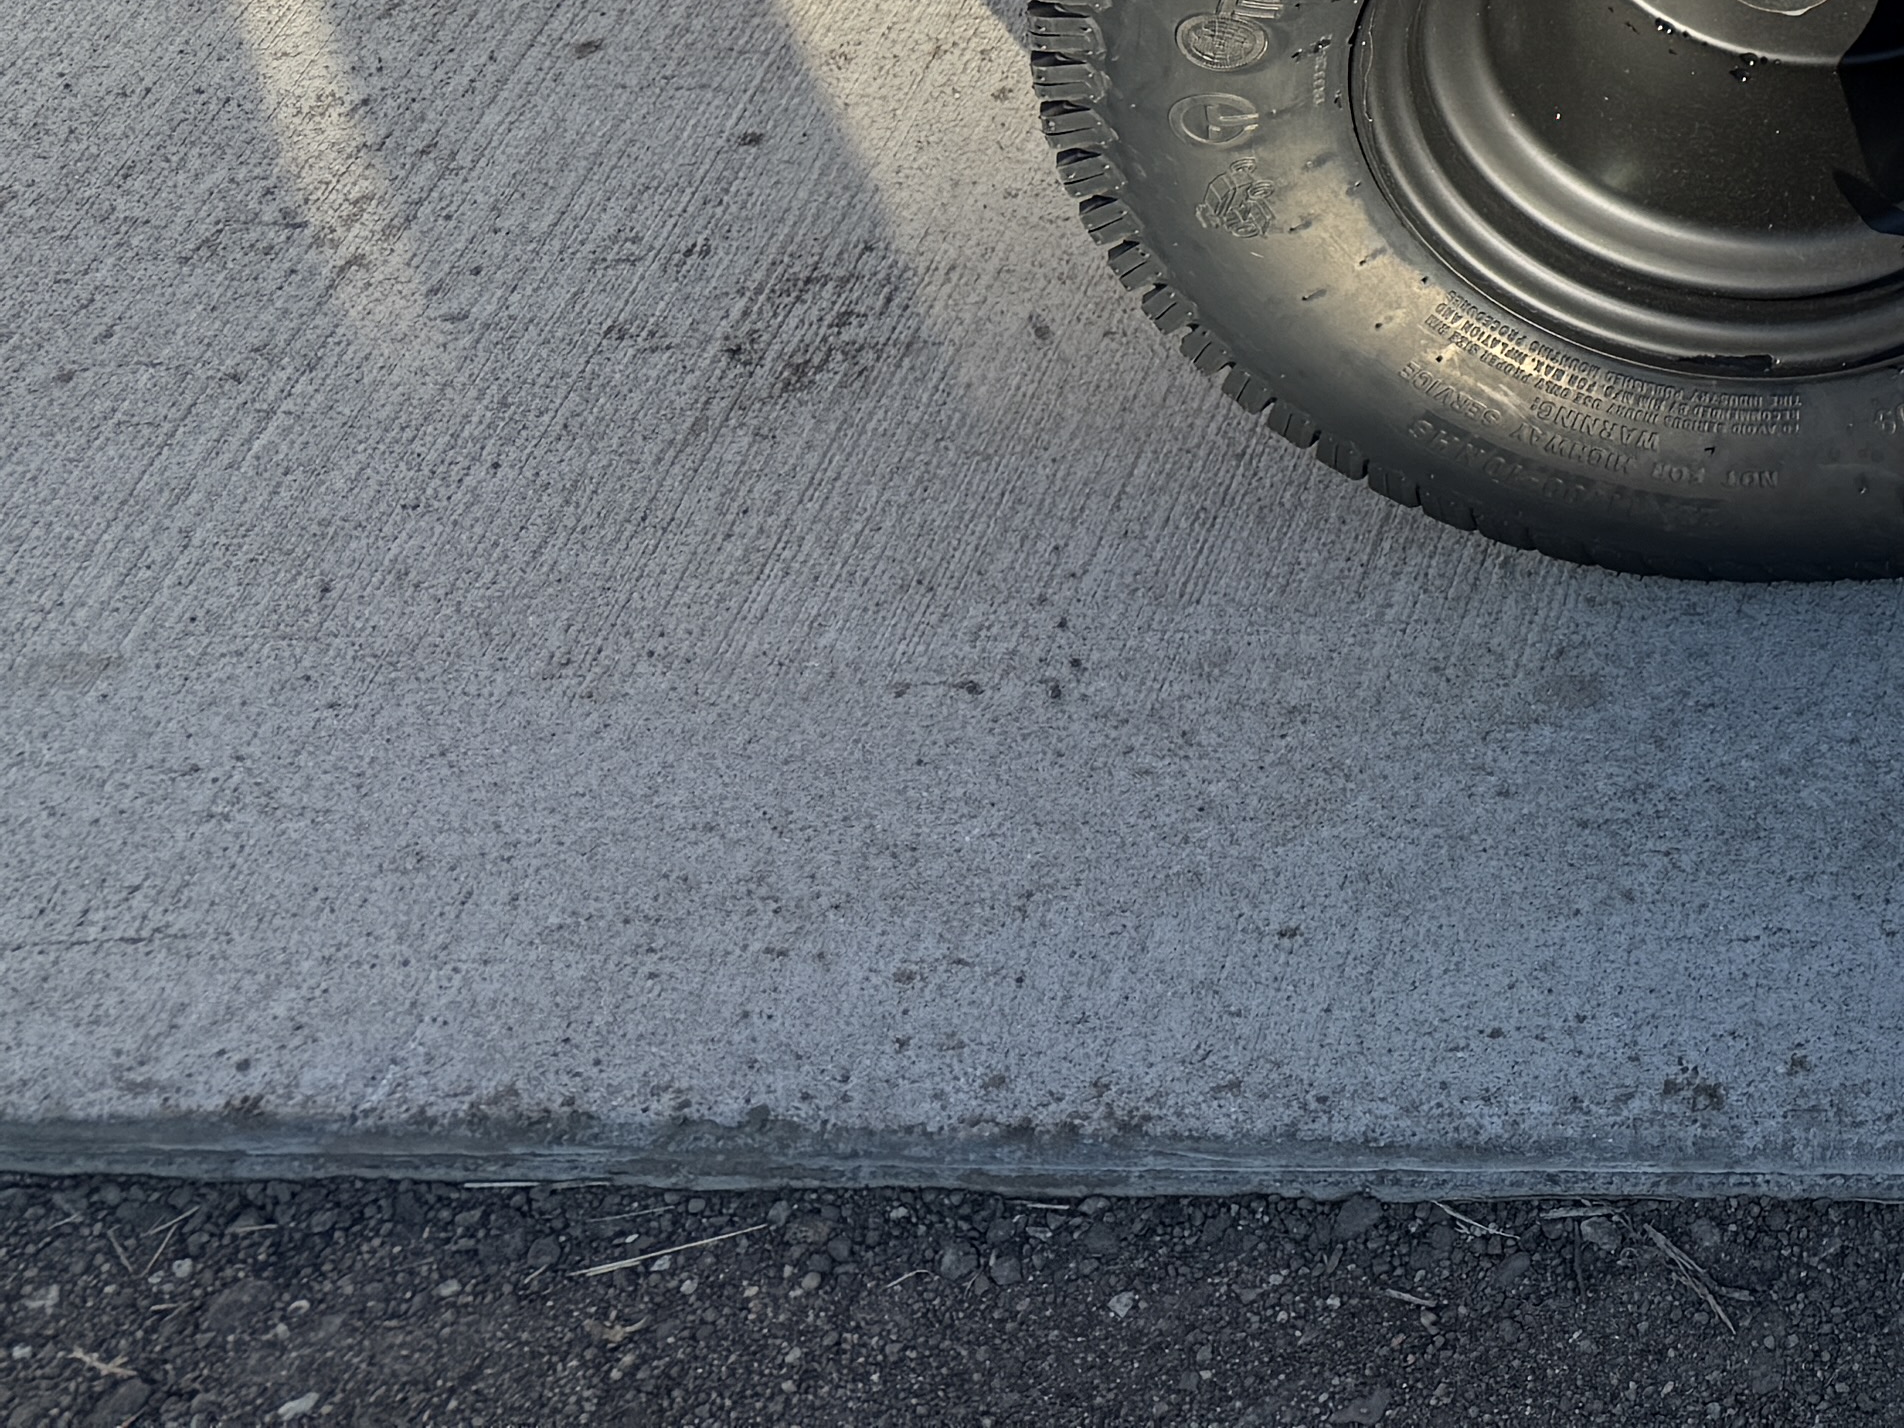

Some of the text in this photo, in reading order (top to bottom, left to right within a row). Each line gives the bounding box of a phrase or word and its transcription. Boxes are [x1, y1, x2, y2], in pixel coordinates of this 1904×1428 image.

[1424, 312, 1450, 337] RIM
[1434, 300, 1464, 327] AND
[1444, 289, 1527, 347] PROCEDURES
[1448, 329, 1480, 356] SIZE
[1460, 319, 1528, 365] INFLATION
[1479, 349, 1533, 384] PROPER
[1527, 356, 1565, 383] MAX.
[1528, 339, 1601, 379] MOUNTING
[1534, 376, 1571, 400] ONLY
[1566, 373, 1596, 395] FOR
[1605, 369, 1677, 399] PUBLISHED
[1571, 390, 1604, 413] USE
[1637, 396, 1665, 411] RIM
[1689, 390, 1762, 407] INDUSTRY
[1399, 361, 1779, 490] NOT FOR HIGHWAY SERVICE
[1530, 396, 1662, 454] WARNING:
[1606, 402, 1658, 425] INJURY
[1663, 414, 1723, 434] SERIOUS
[1693, 405, 1800, 421] RECOMMENDED
[1732, 422, 1777, 435] AVOID
